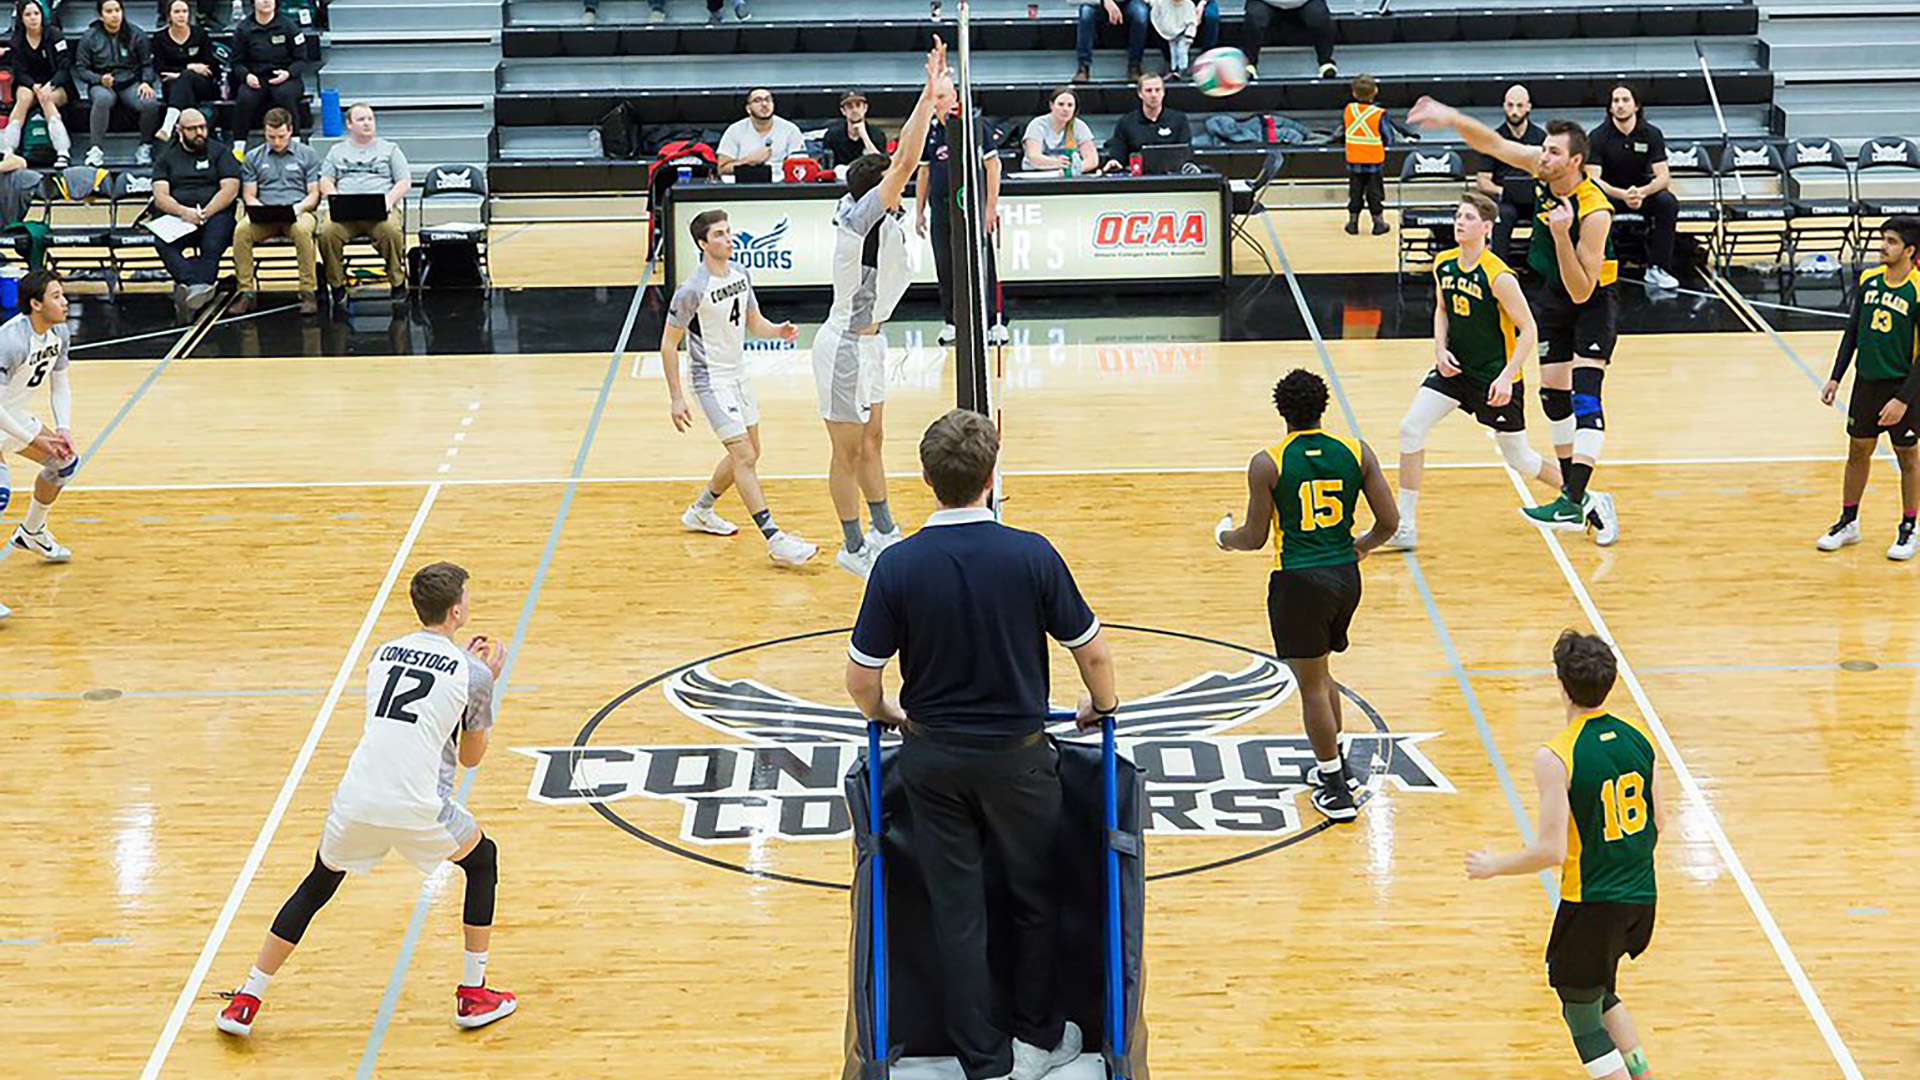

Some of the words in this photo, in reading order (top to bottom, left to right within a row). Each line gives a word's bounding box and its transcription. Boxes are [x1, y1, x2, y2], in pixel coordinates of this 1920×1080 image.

[1093, 212, 1206, 248] OCAA
[728, 297, 741, 327] 4
[1870, 308, 1893, 333] 13
[1298, 479, 1344, 531] 15
[379, 645, 460, 676] CONESTOGA
[374, 664, 436, 725] 12
[688, 787, 1289, 840] CORS
[1600, 770, 1648, 842] 18
